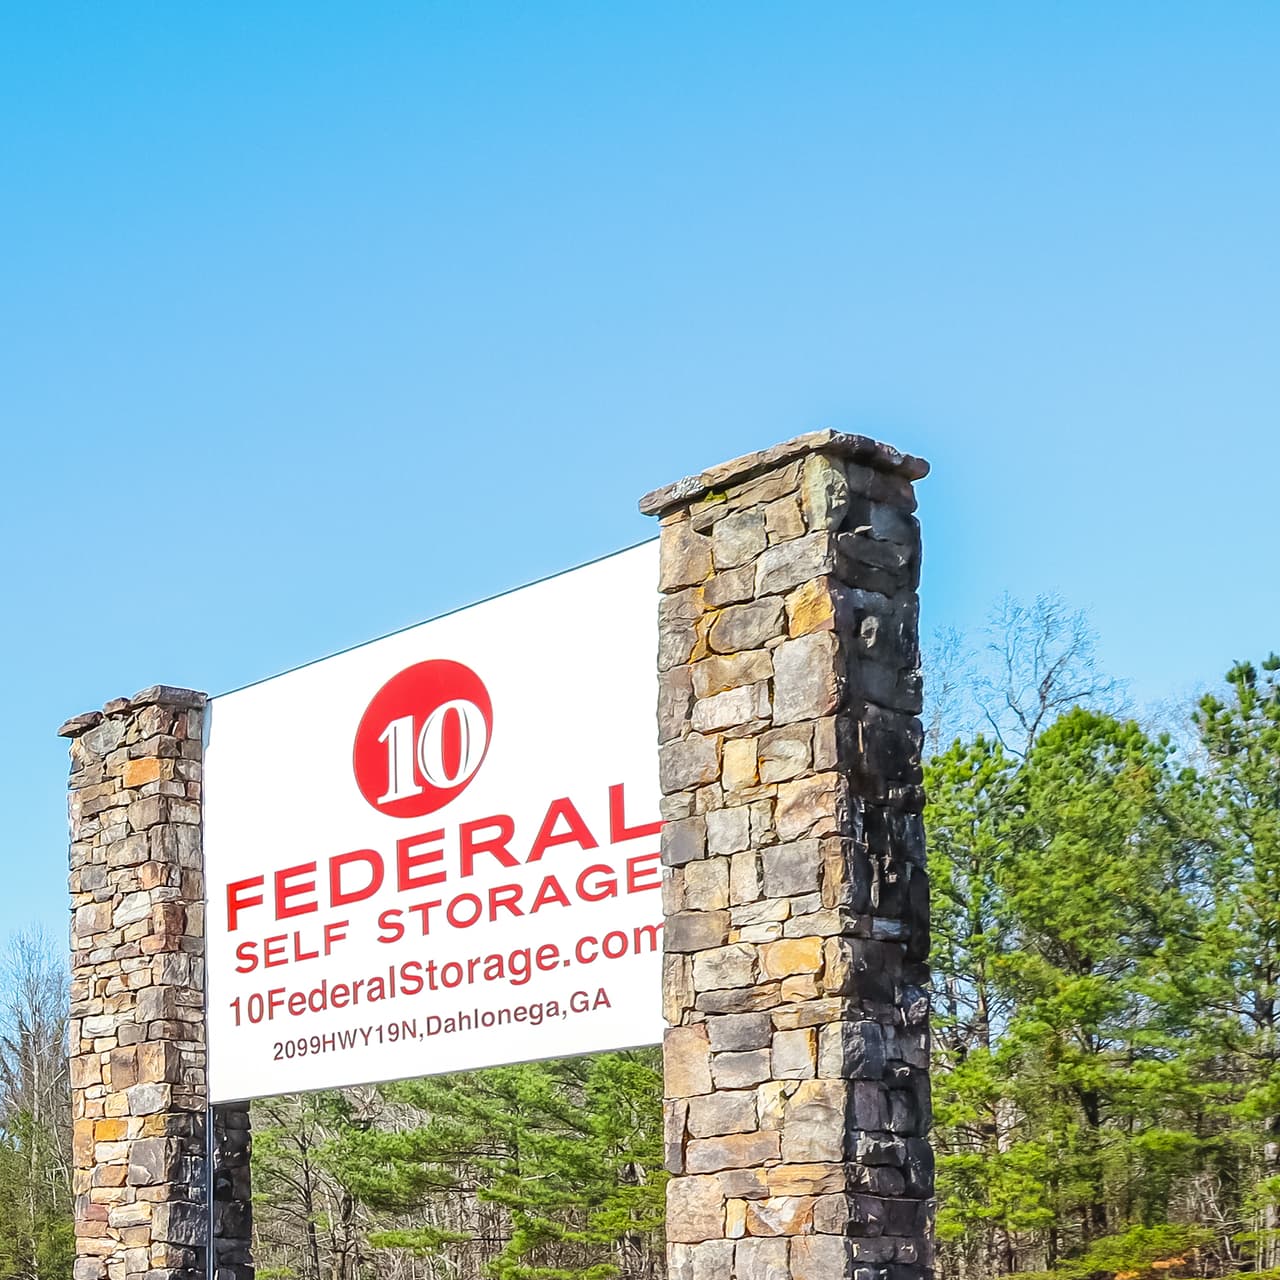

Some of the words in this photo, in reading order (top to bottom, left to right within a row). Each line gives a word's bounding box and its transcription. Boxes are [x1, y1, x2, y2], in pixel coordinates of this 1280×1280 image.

[376, 698, 488, 805] 10
[226, 782, 666, 932] FEDERAL
[235, 919, 349, 974] SELF
[376, 852, 662, 944] STORAGE
[229, 921, 665, 1027] 10FederalStorage.com
